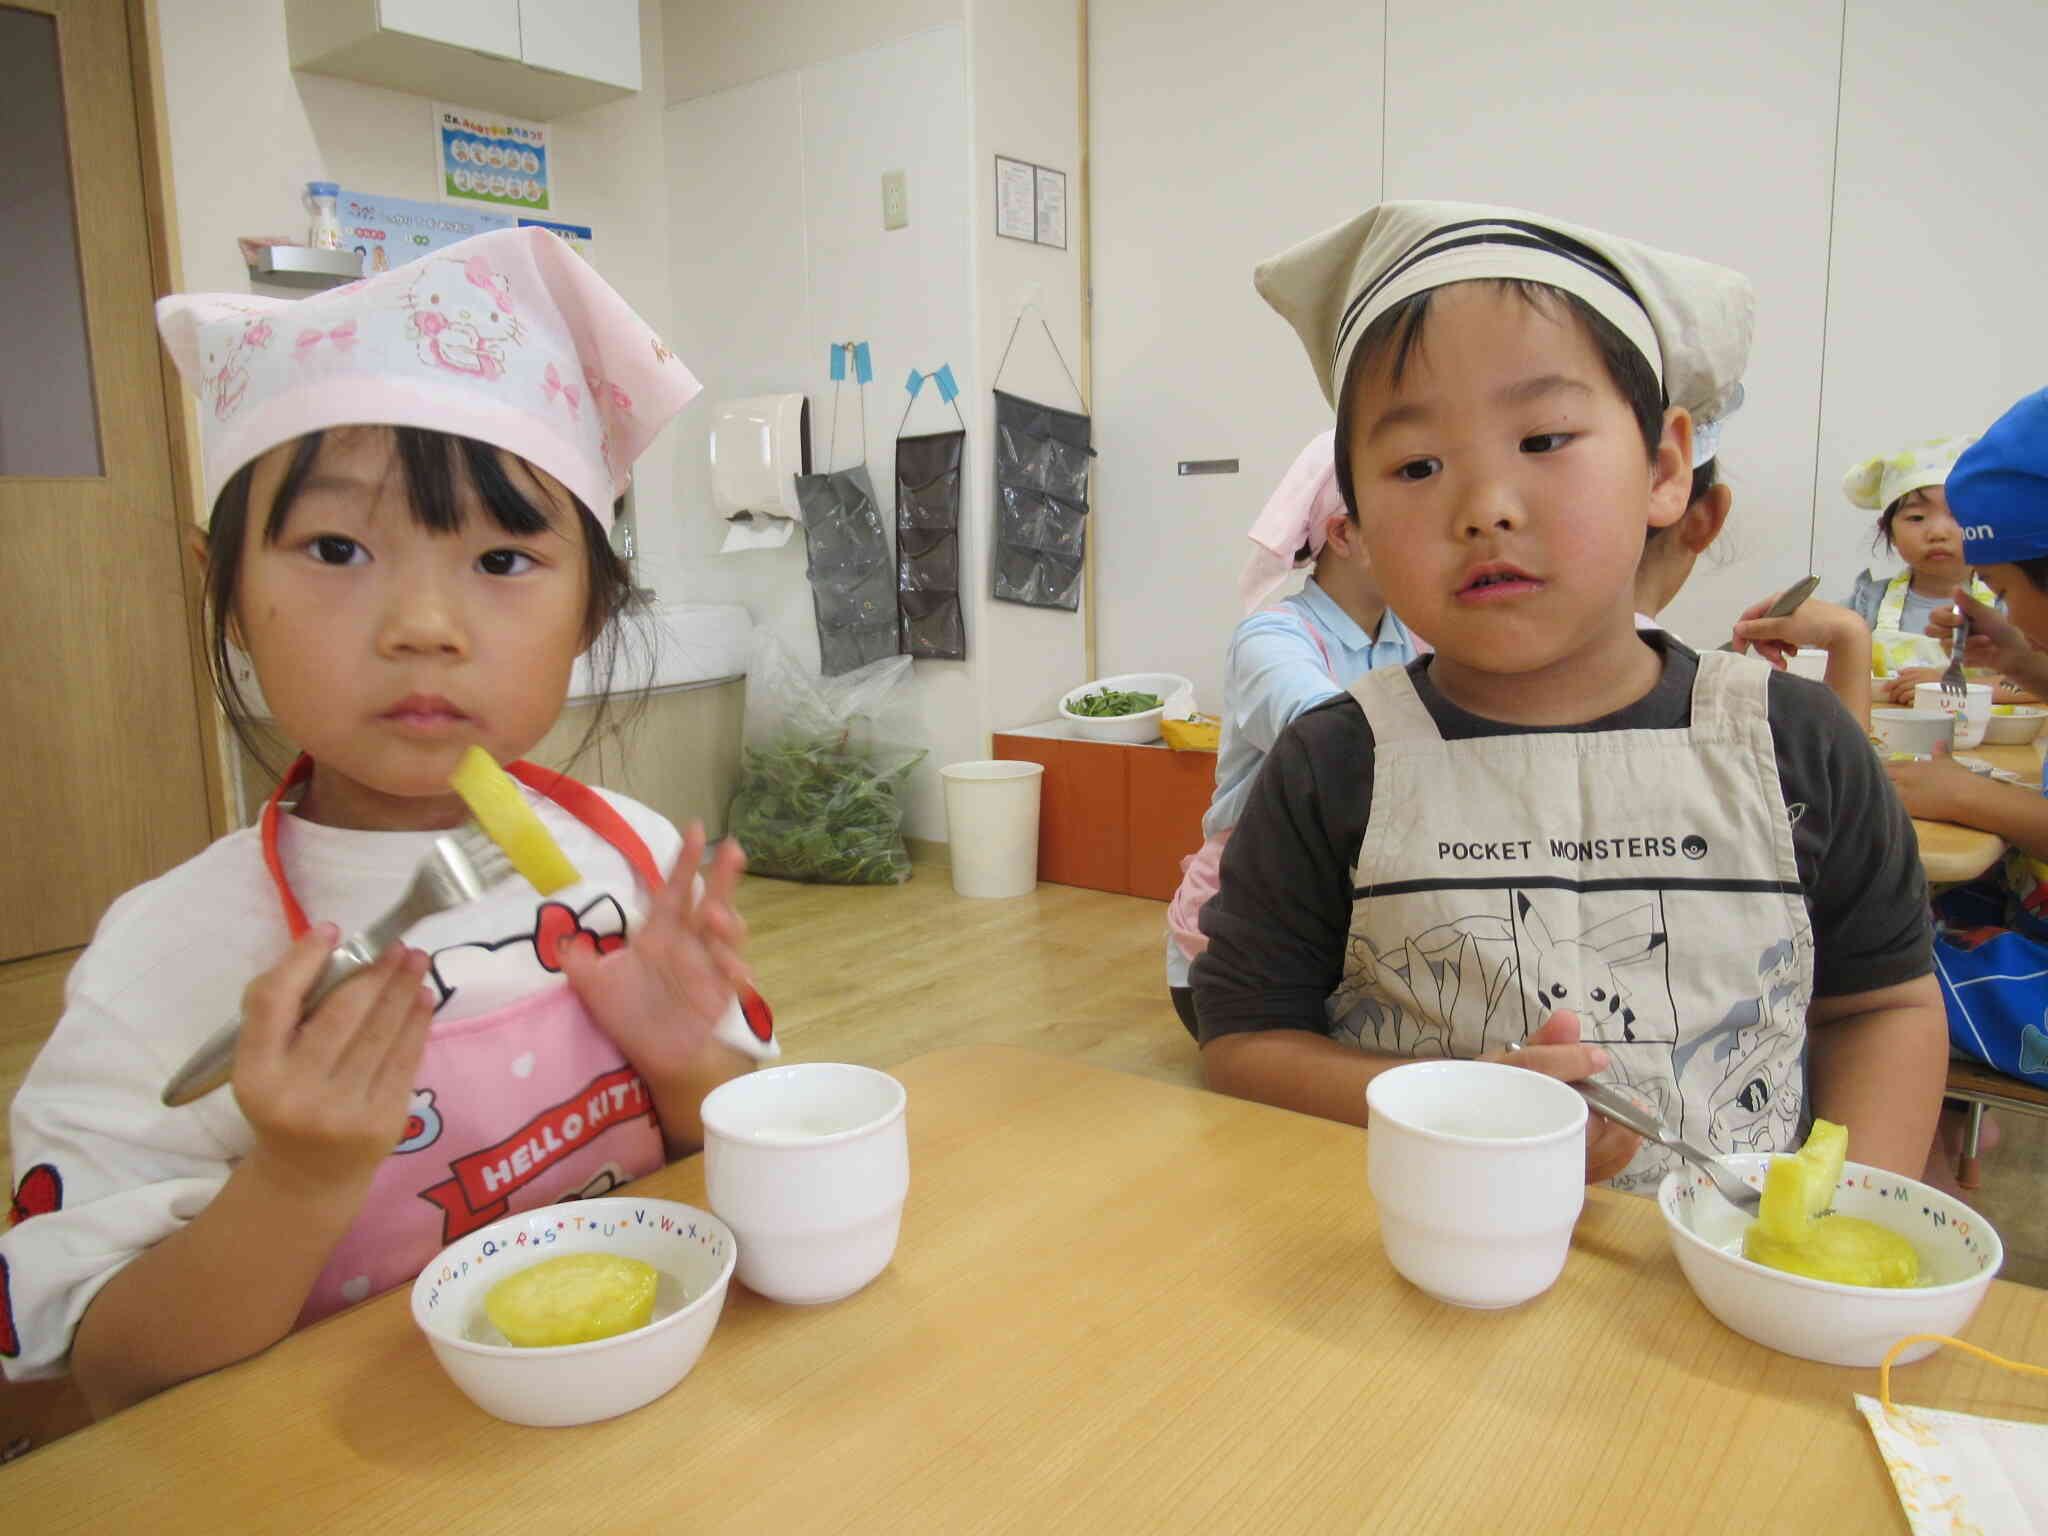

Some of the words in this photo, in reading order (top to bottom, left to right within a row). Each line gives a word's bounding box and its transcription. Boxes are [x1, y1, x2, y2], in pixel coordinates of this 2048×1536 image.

[1959, 525, 1994, 541] on
[1438, 841, 1532, 860] POCKET
[1549, 836, 1676, 861] MONSTERS
[481, 1113, 584, 1192] HELLO
[1933, 1211, 1946, 1227] N
[482, 1240, 499, 1256] Q
[516, 1231, 528, 1246] R
[544, 1228, 556, 1243] S
[574, 1217, 584, 1230] T
[604, 1224, 615, 1237] U
[635, 1210, 645, 1224] V
